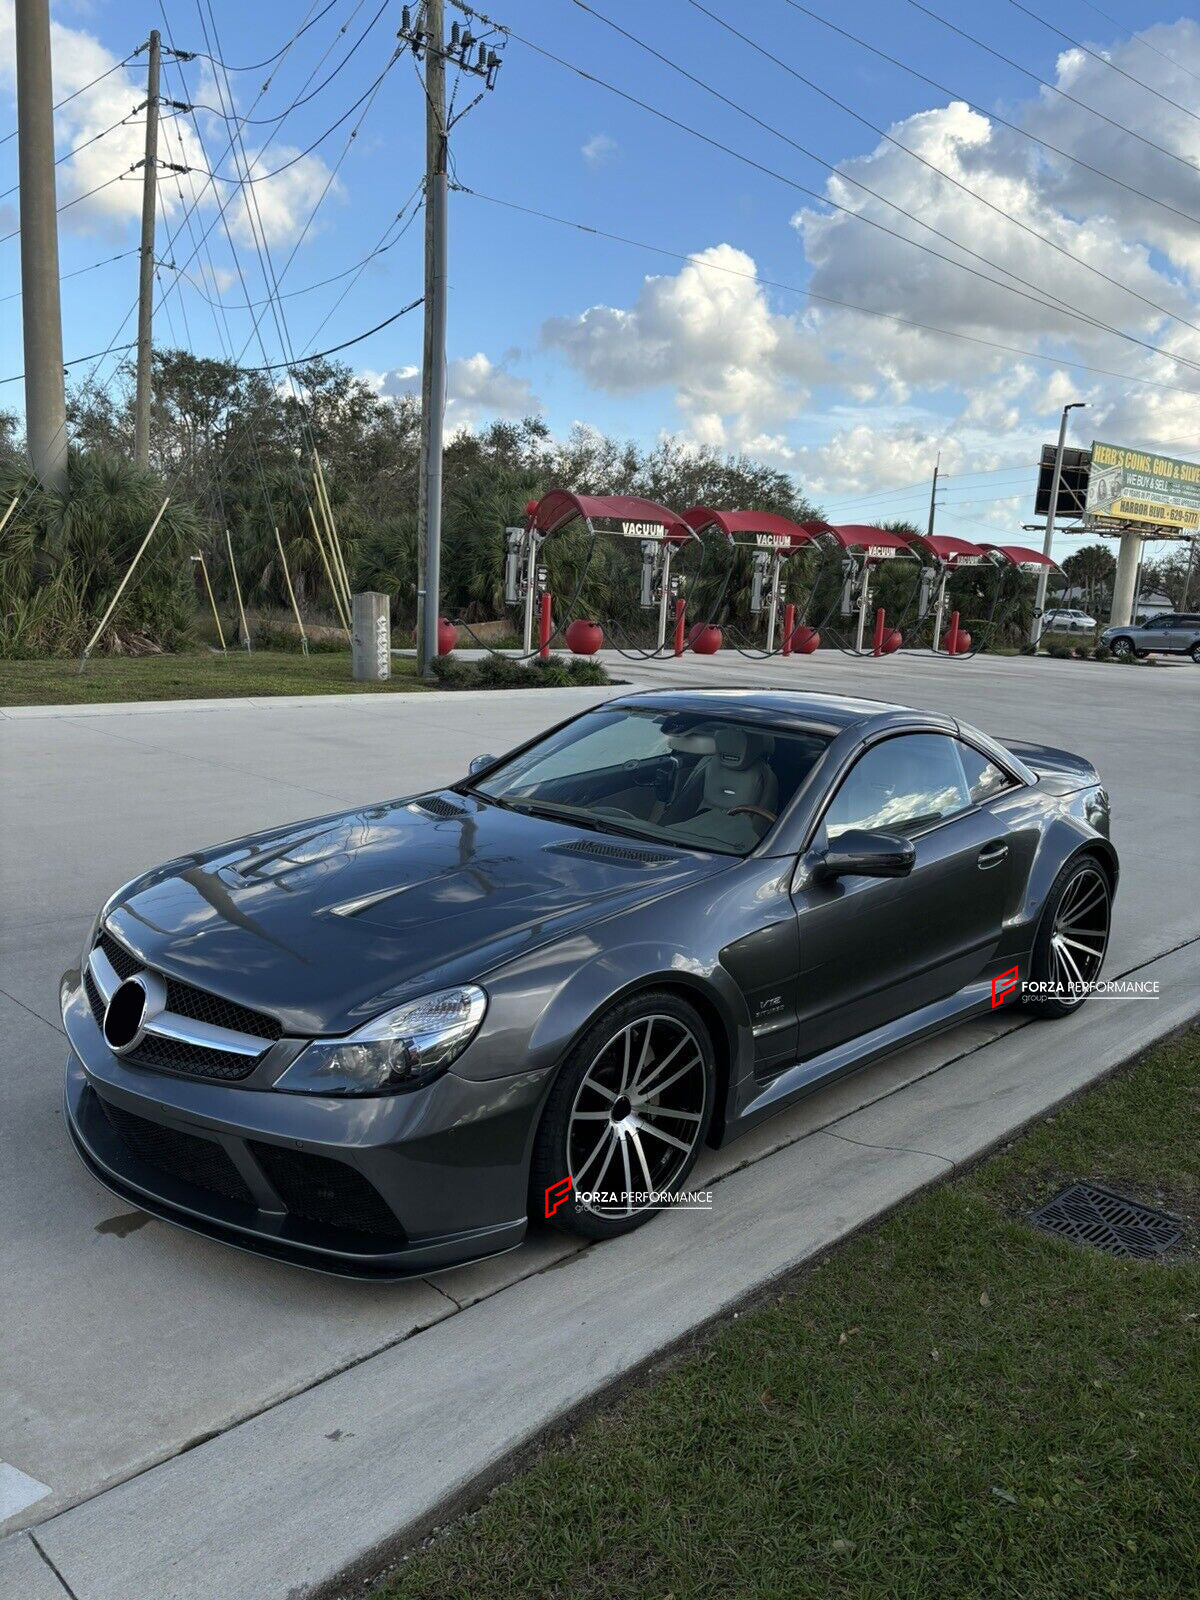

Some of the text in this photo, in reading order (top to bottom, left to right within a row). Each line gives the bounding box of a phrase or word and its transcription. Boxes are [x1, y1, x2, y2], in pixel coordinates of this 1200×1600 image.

[1153, 458, 1173, 478] GOLD
[1173, 465, 1180, 479] &
[1126, 472, 1137, 485] WE
[1137, 475, 1150, 488] BUY
[1150, 478, 1155, 489] &
[1155, 479, 1169, 492] SELL
[1120, 500, 1148, 516] HARBOR
[622, 522, 665, 538] VACUUM
[756, 534, 792, 548] VACUUM
[868, 545, 896, 558] VACUUM
